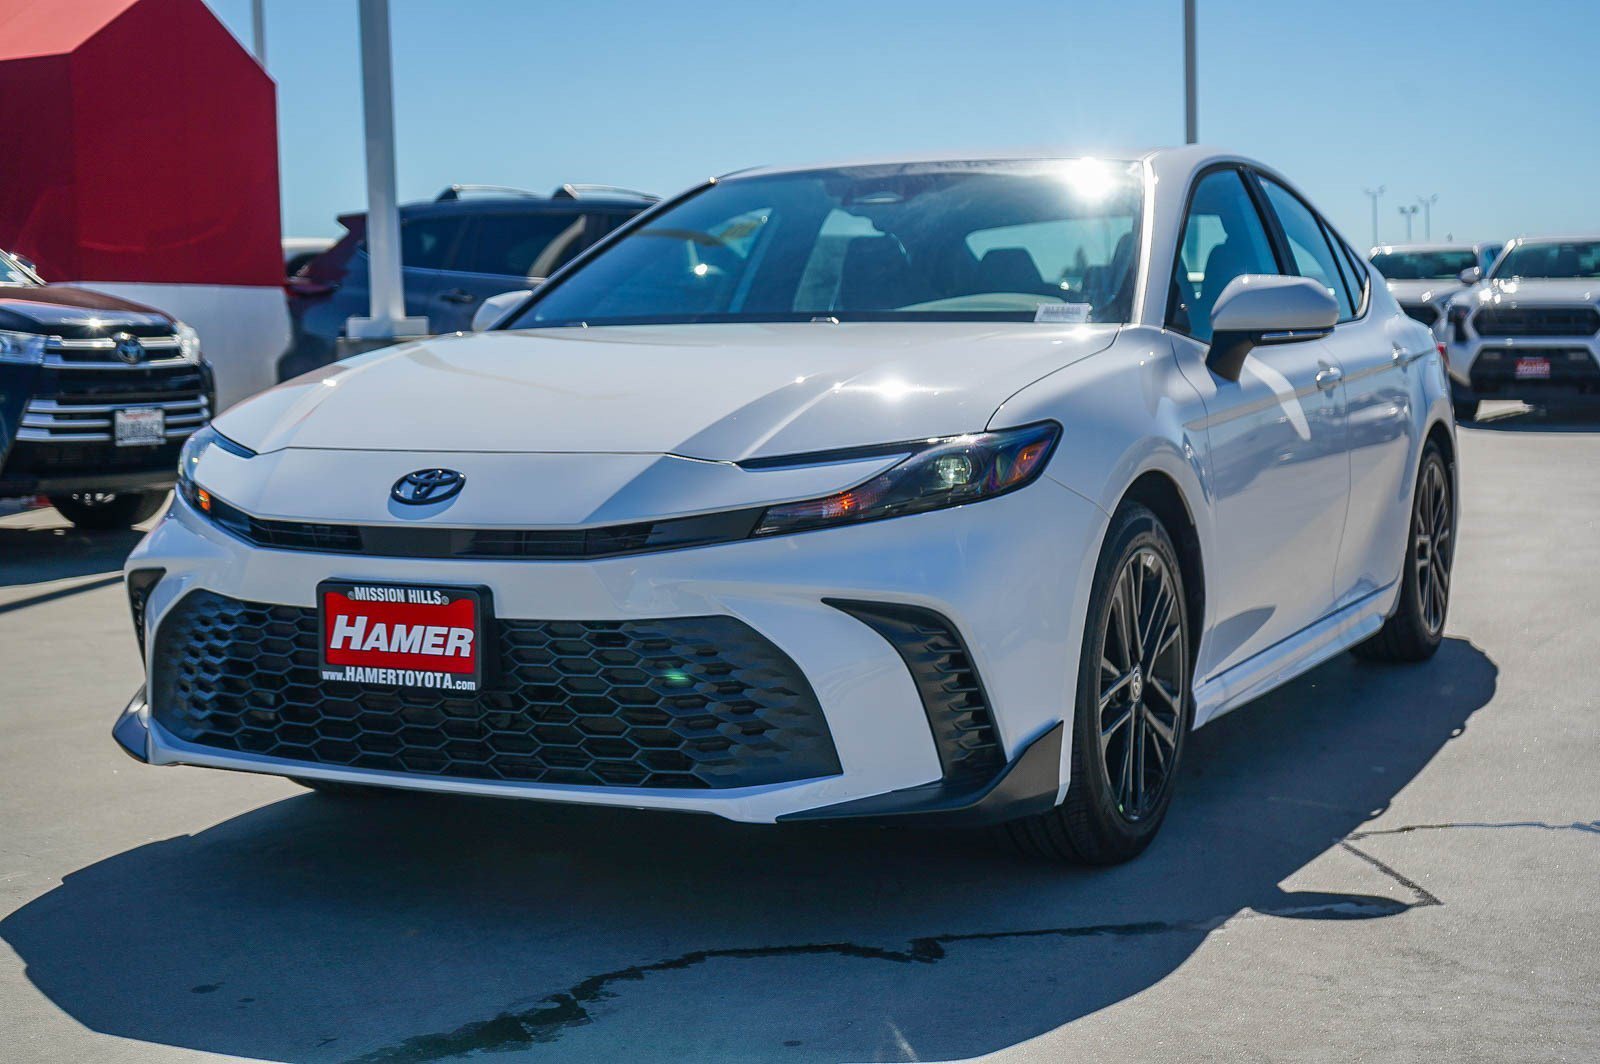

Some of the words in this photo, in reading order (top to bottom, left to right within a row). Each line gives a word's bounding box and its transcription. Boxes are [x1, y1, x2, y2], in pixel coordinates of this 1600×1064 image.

[354, 587, 405, 603] MISSION
[408, 589, 441, 605] HILLS
[330, 614, 474, 657] HAMER
[322, 666, 476, 691] www.HAMERTOYOTA.com
